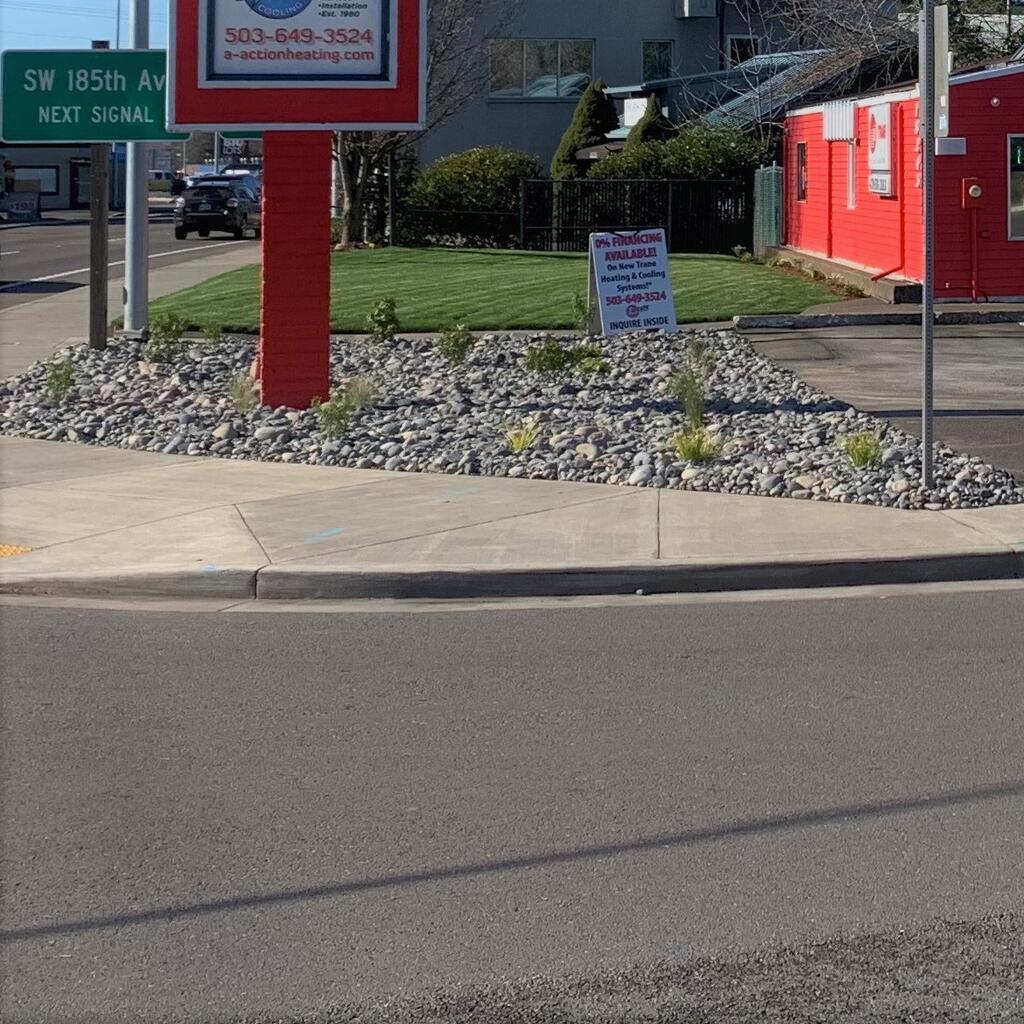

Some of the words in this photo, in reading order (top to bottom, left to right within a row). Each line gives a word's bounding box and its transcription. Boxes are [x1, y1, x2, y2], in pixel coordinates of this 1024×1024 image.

[258, 2, 304, 17] COOLING
[224, 27, 374, 45] 503-649-3524
[223, 47, 375, 64] a-actionheating.com
[23, 68, 56, 92] SW
[67, 68, 127, 92] 185th
[137, 69, 166, 92] Av
[38, 106, 82, 123] NEXT
[91, 106, 154, 123] SIGNAL
[613, 233, 662, 247] FINANCING
[620, 262, 634, 270] New
[601, 274, 630, 283] Heating
[639, 270, 666, 279] Cooling
[606, 292, 667, 305] 503-649-3524
[610, 319, 642, 330] INQUIRE
[643, 316, 669, 327] INSIDE
